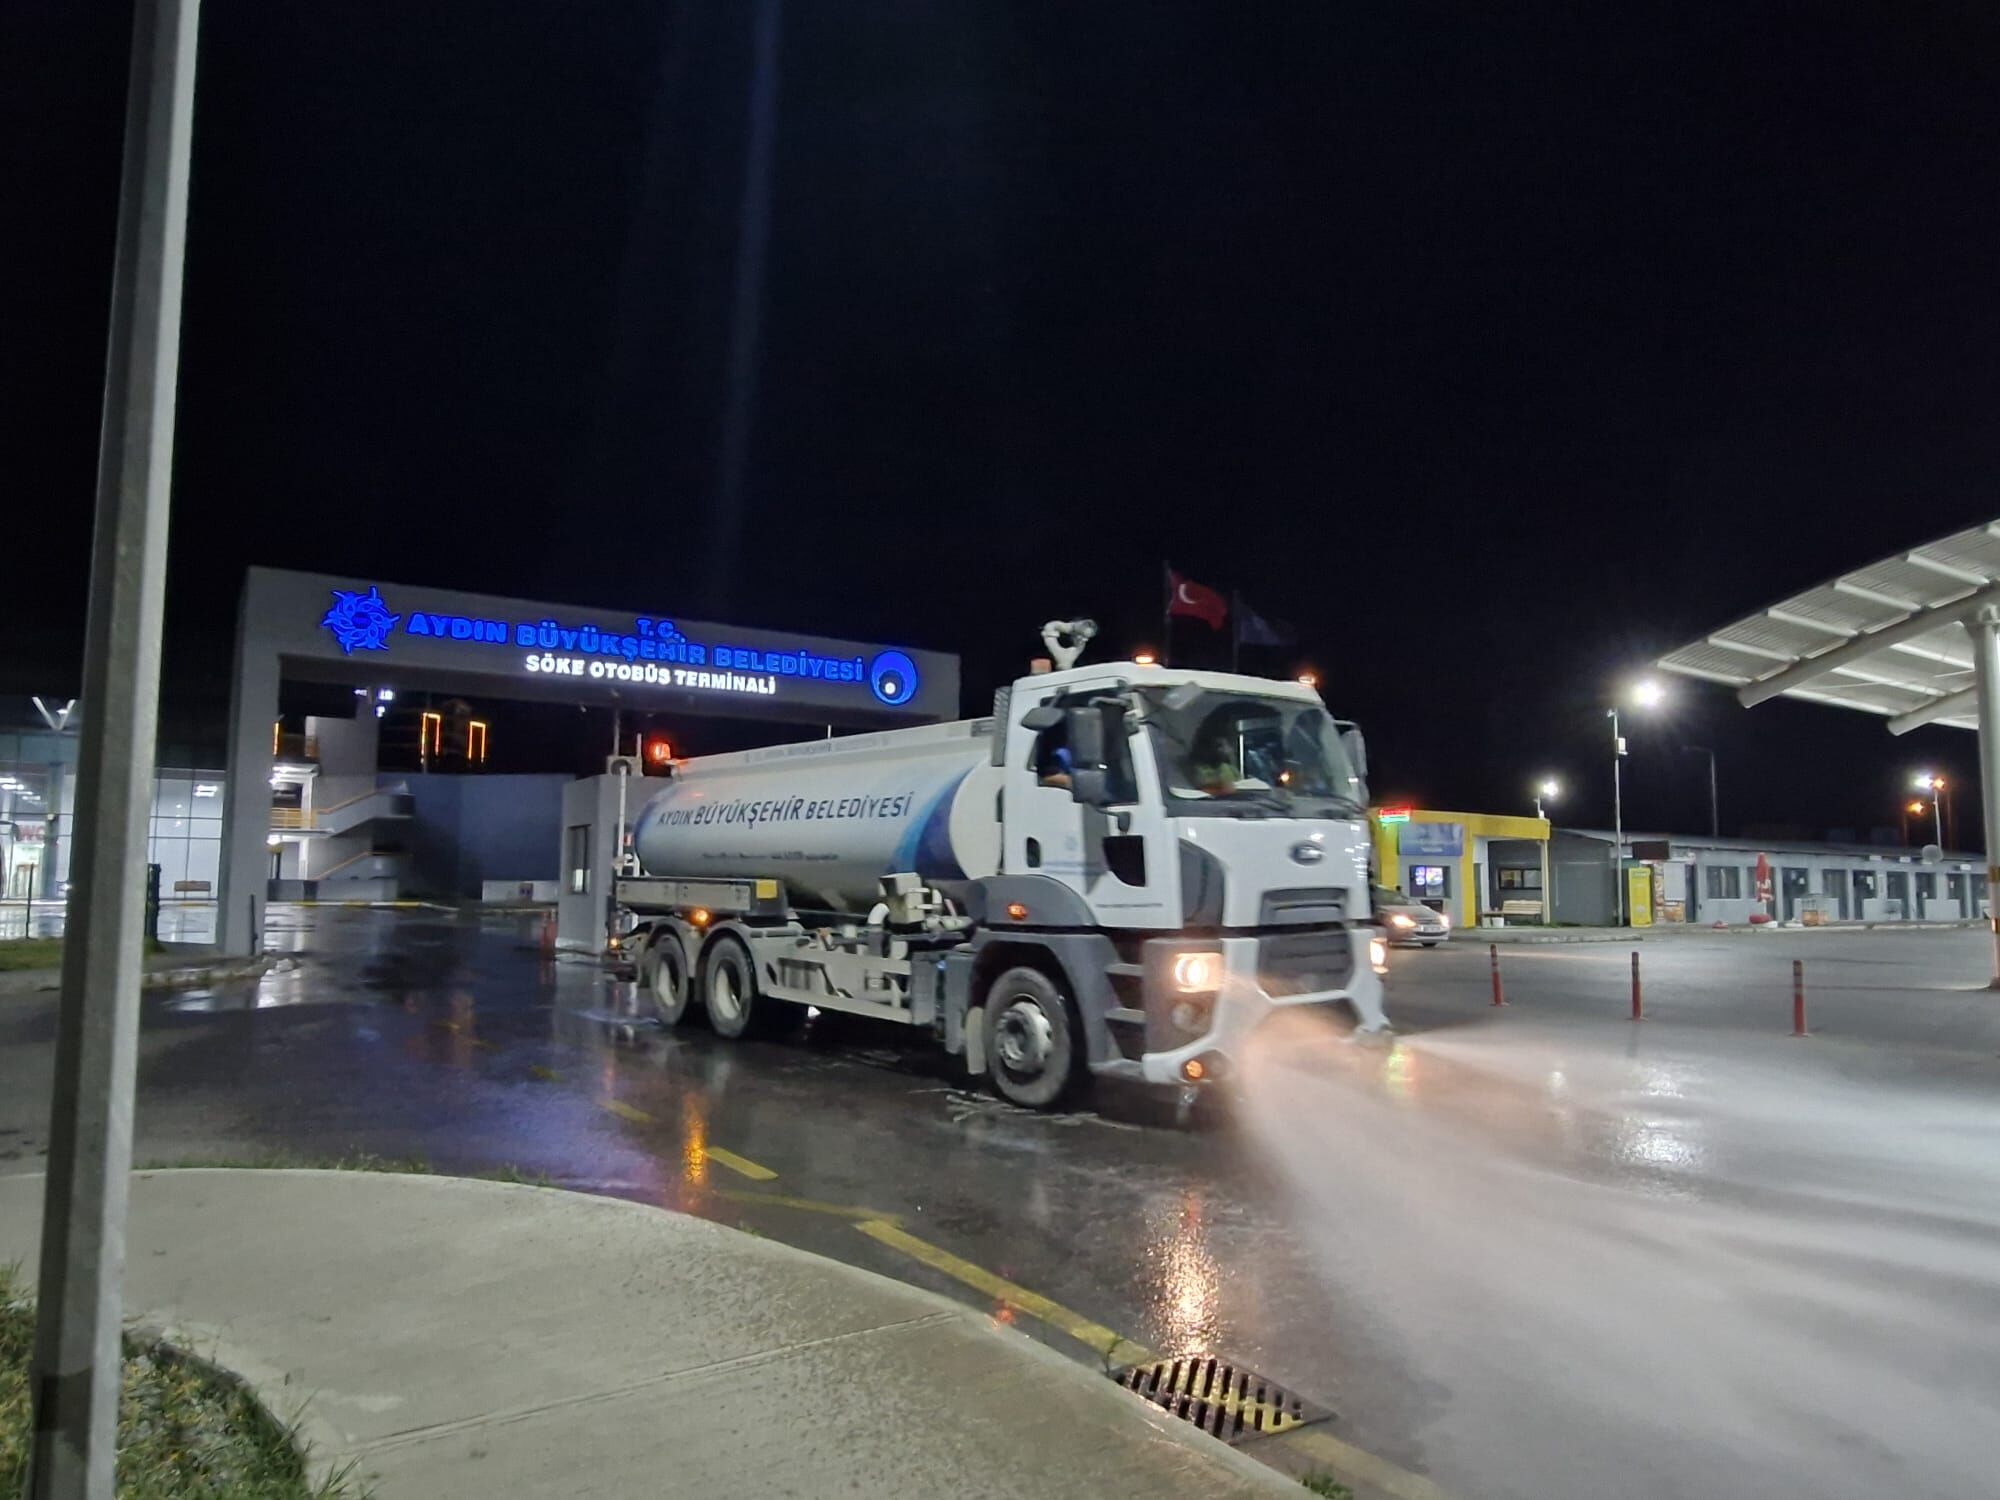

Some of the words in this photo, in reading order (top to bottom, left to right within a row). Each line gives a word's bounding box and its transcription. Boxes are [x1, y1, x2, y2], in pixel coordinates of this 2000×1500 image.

[407, 612, 507, 643] AYDIN
[516, 620, 706, 664] BÜYÜKŞEHİR
[715, 647, 864, 682] BELEDİYESİ
[525, 653, 585, 676] SÖKE
[590, 661, 671, 685] OTOBÜS
[676, 669, 776, 695] TERMİNALİ
[657, 809, 693, 826] AYDIN
[693, 795, 805, 830] BÜYÜKŞEHİR
[805, 791, 915, 820] BELEDİYESİ
